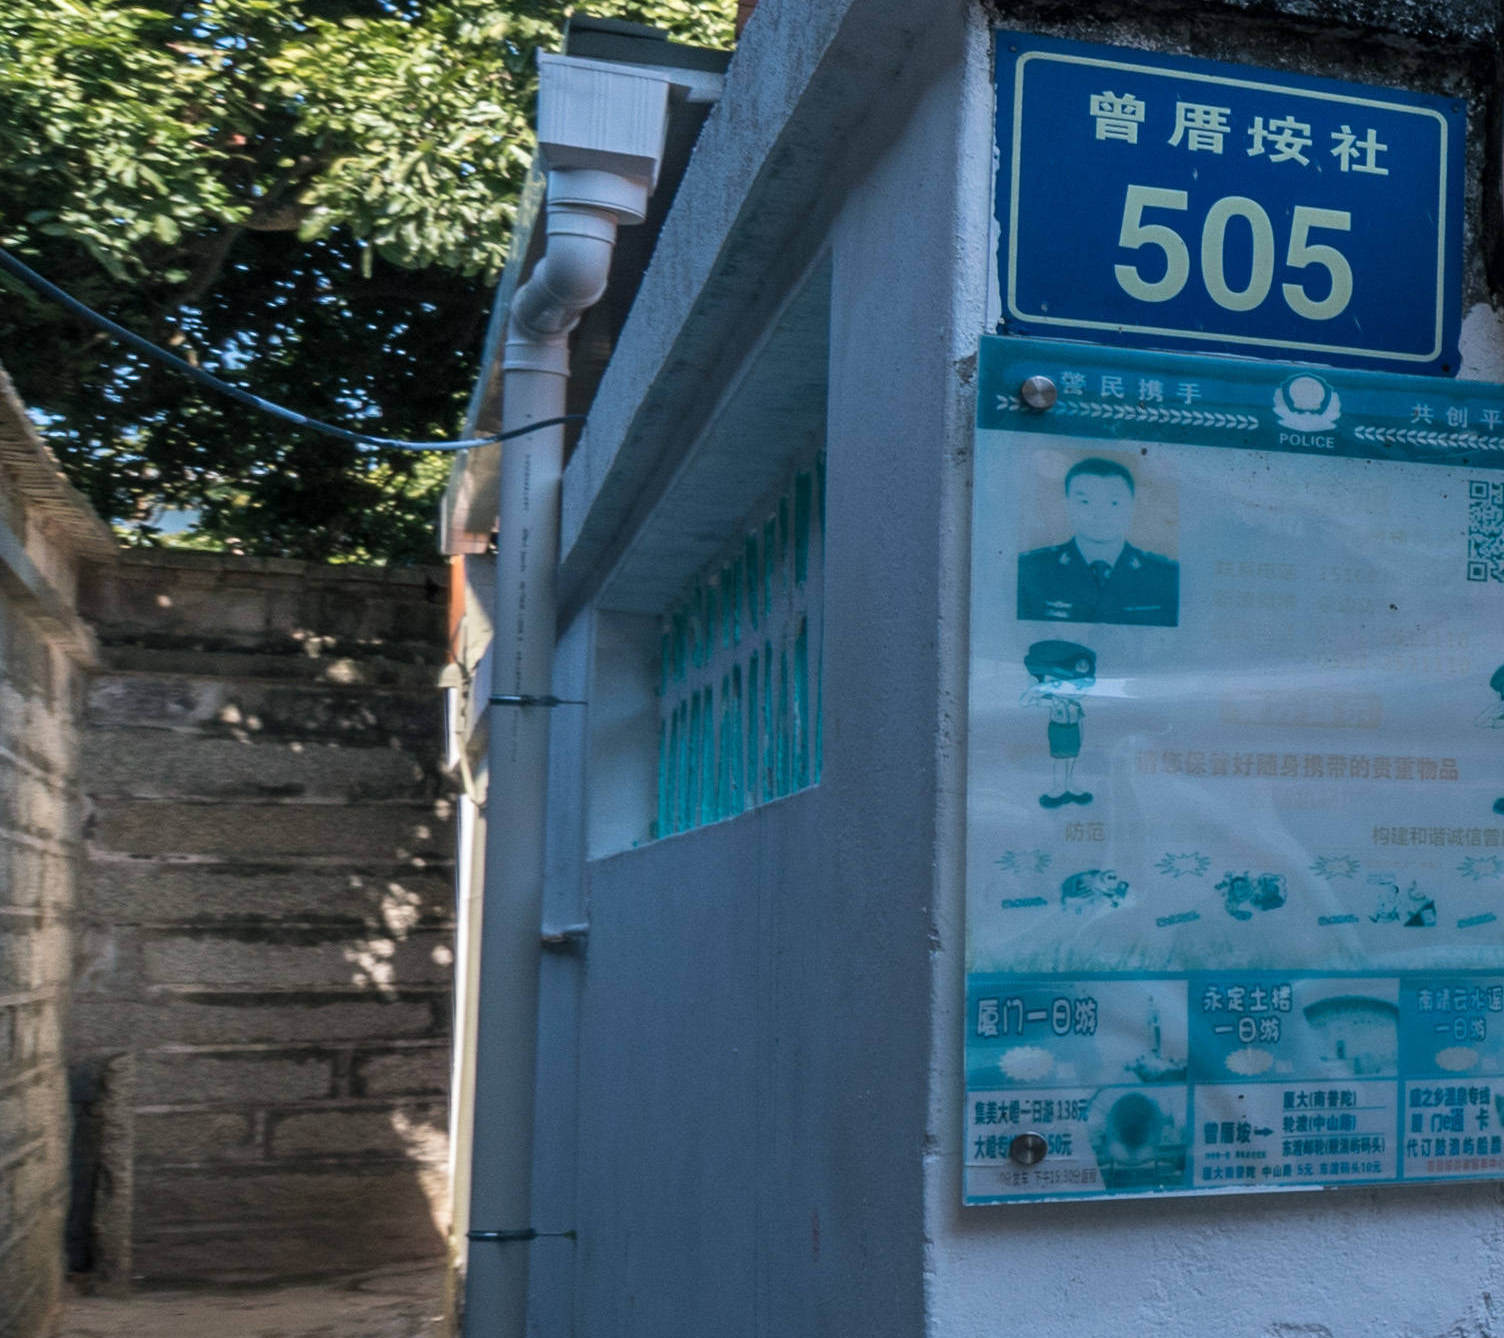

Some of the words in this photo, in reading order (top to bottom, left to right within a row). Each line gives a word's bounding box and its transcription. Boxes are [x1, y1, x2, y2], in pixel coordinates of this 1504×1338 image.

[1089, 90, 1389, 175] 曾厝垵社
[1114, 184, 1354, 321] 505
[1060, 370, 1202, 404] 警民携手
[1279, 432, 1335, 449] POLICE
[976, 997, 1098, 1037] 厦门一日游
[1215, 1017, 1280, 1043] 一日游
[1435, 1018, 1486, 1041] 一日游
